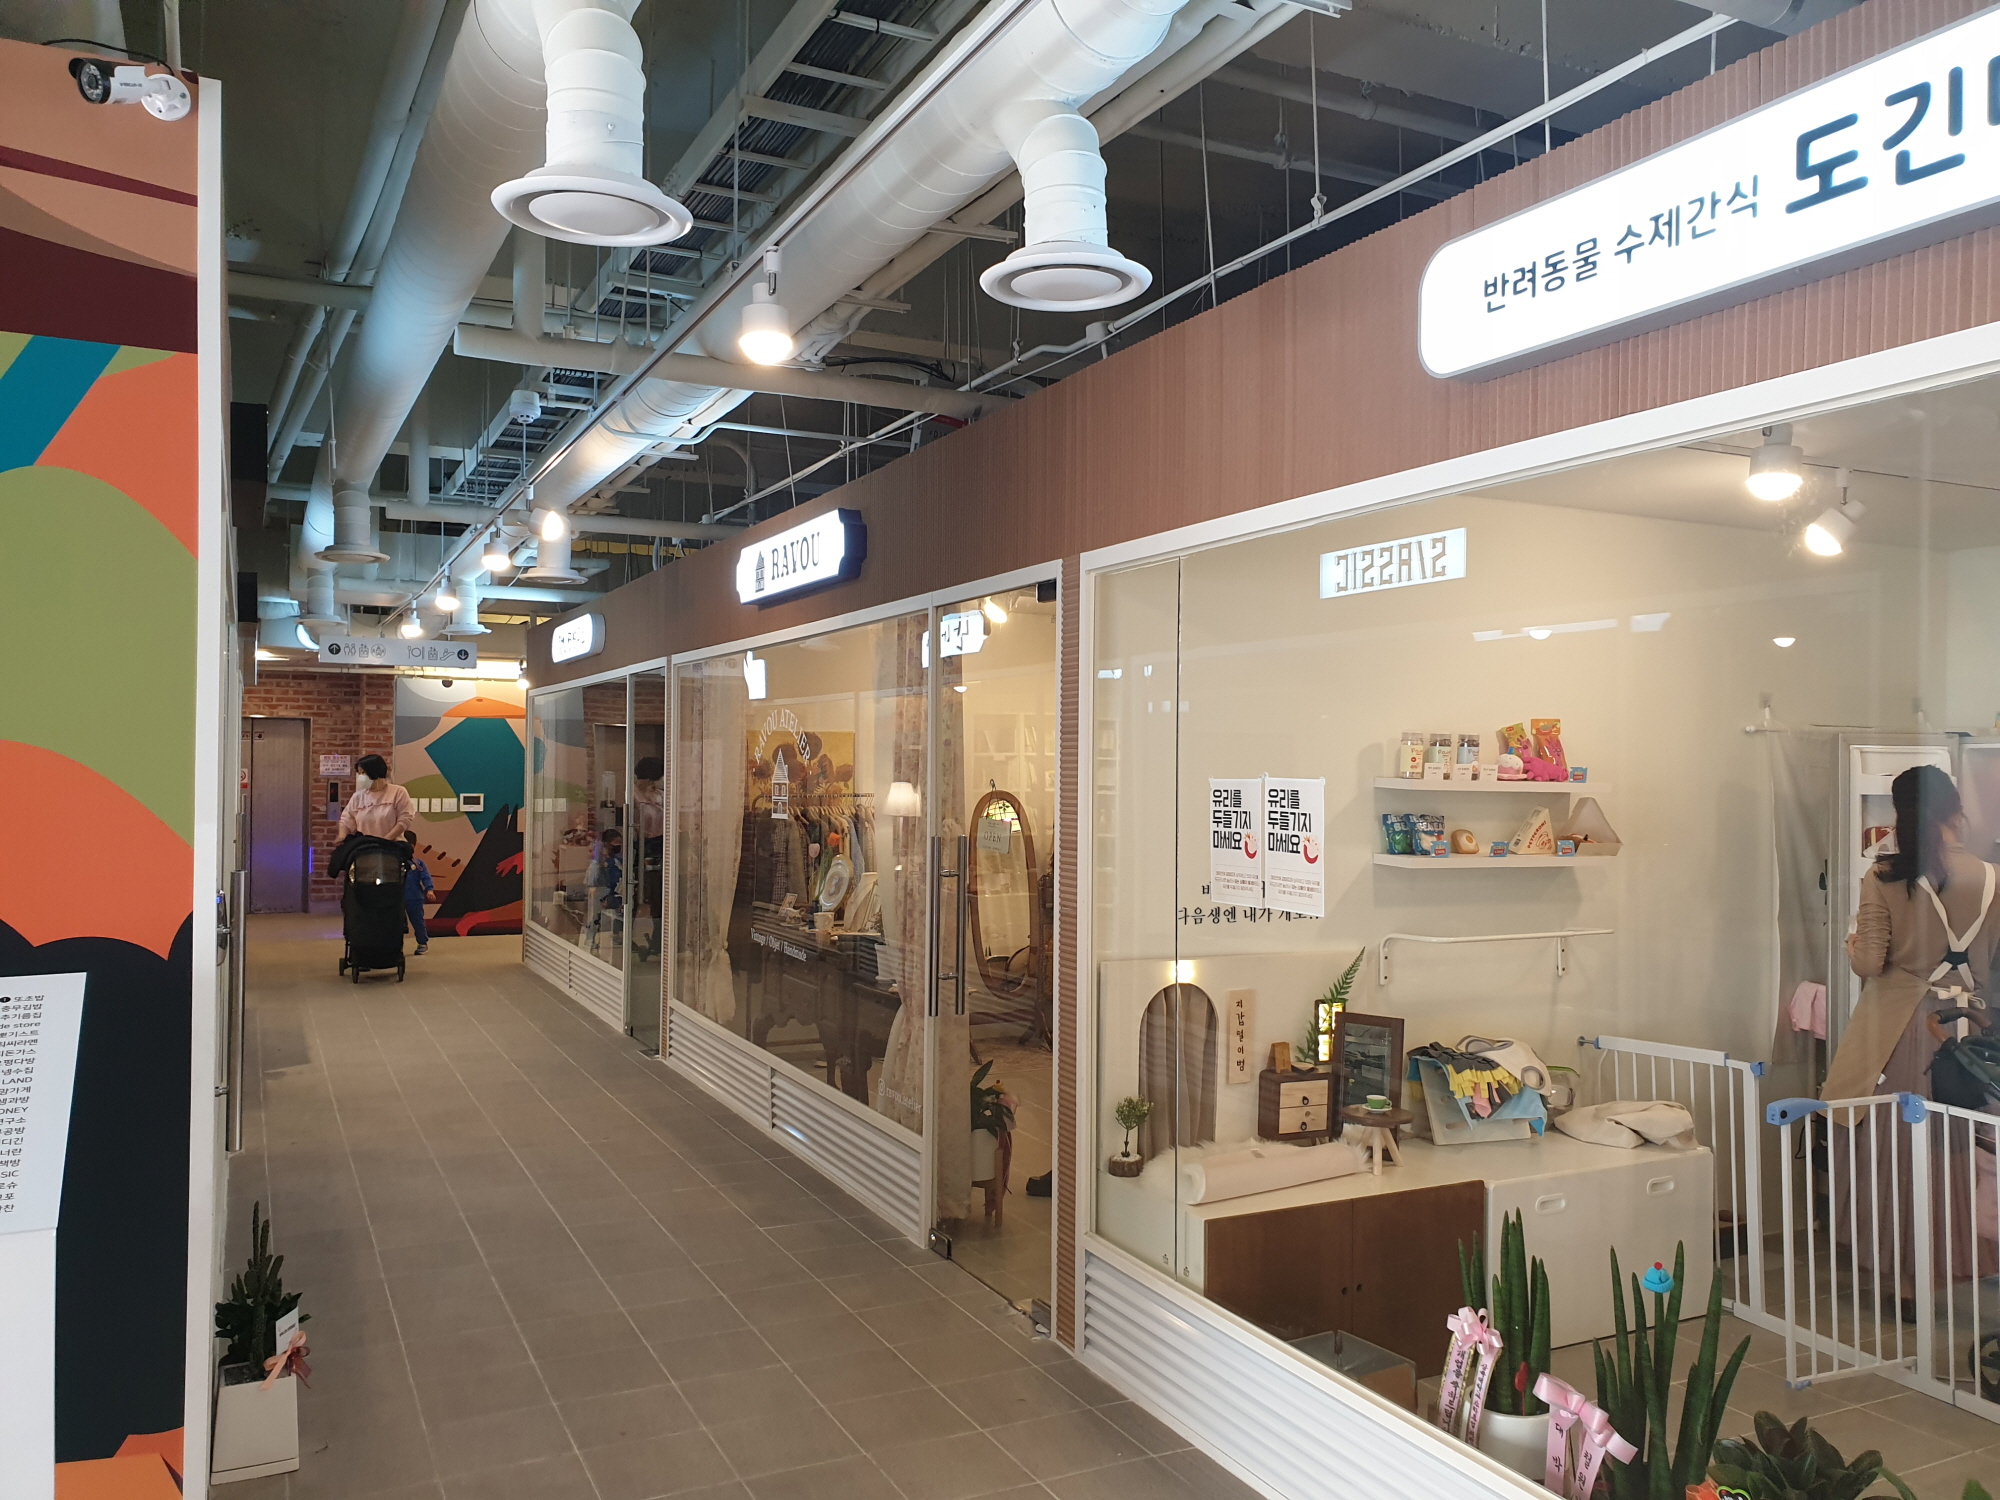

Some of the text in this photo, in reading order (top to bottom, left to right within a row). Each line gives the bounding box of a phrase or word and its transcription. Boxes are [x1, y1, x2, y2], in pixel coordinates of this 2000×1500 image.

[1484, 52, 2000, 314] 반려동물 수제간식 도긴
[771, 532, 820, 581] RAVOU
[754, 708, 811, 767] RAVOU ATELIER
[1212, 789, 1242, 808] 유리를
[1267, 788, 1301, 810] 유리를
[1212, 810, 1252, 830] 두들기지
[1267, 810, 1312, 833] 두들기지
[983, 831, 1003, 843] OPEN
[1212, 830, 1243, 850] 마세요
[1267, 832, 1301, 854] 마세요
[1243, 907, 1273, 923] 내가
[13, 1021, 41, 1029] store
[2, 1077, 33, 1085] LAND
[0, 1127, 25, 1136] 공방
[1, 1170, 19, 1179] SIC
